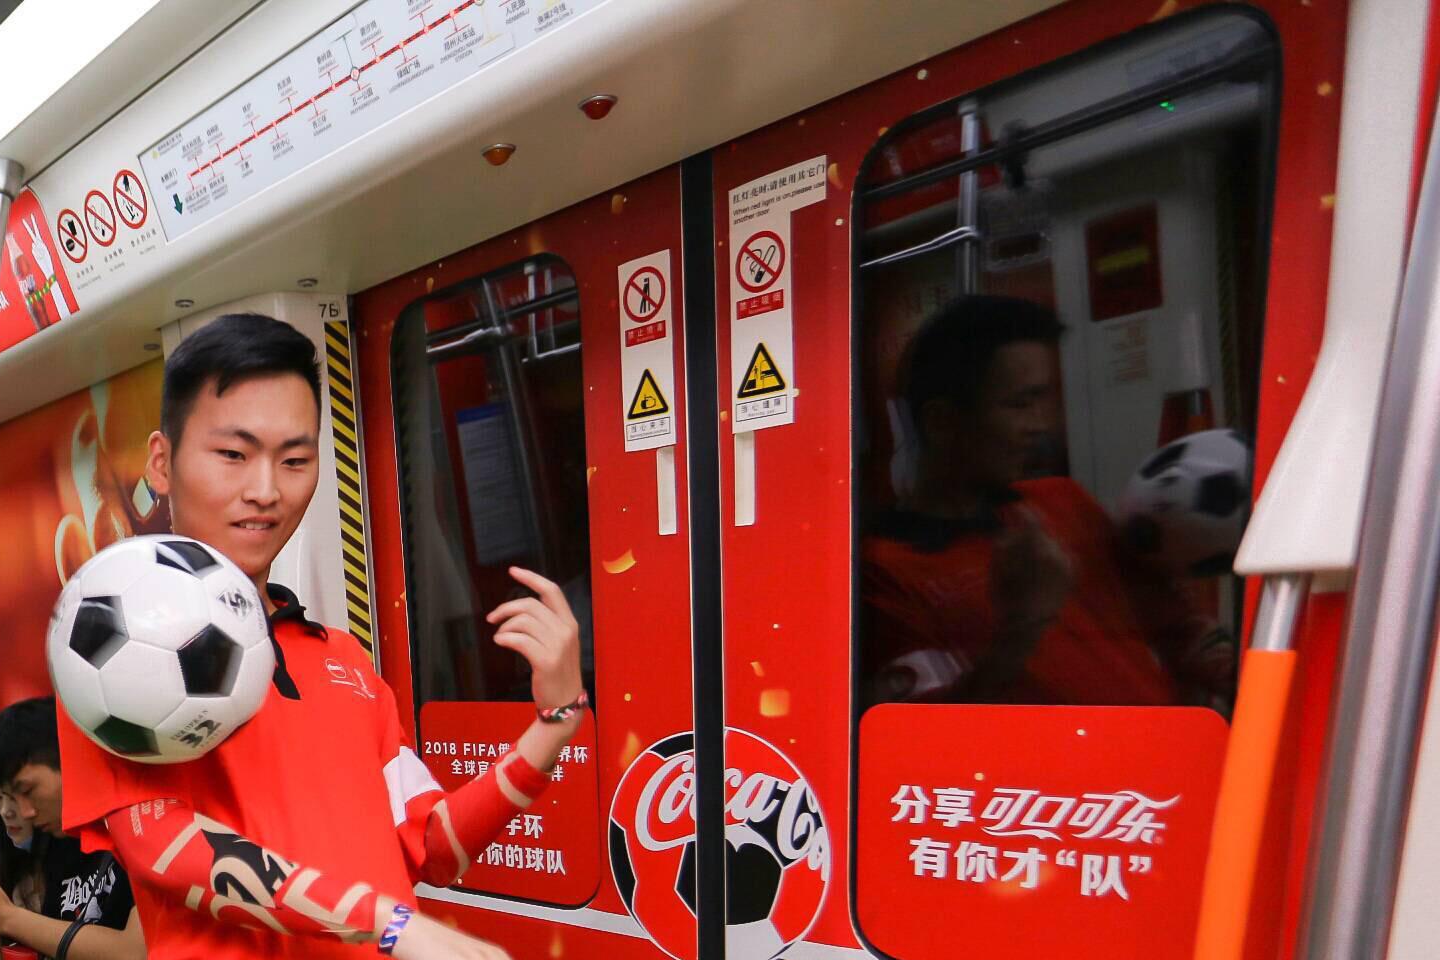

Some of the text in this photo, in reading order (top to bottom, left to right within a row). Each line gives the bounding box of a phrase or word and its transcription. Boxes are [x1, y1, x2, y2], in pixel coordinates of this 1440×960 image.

[425, 741, 457, 756] 2018
[505, 813, 543, 840] 手环
[477, 842, 567, 876] 你的球队
